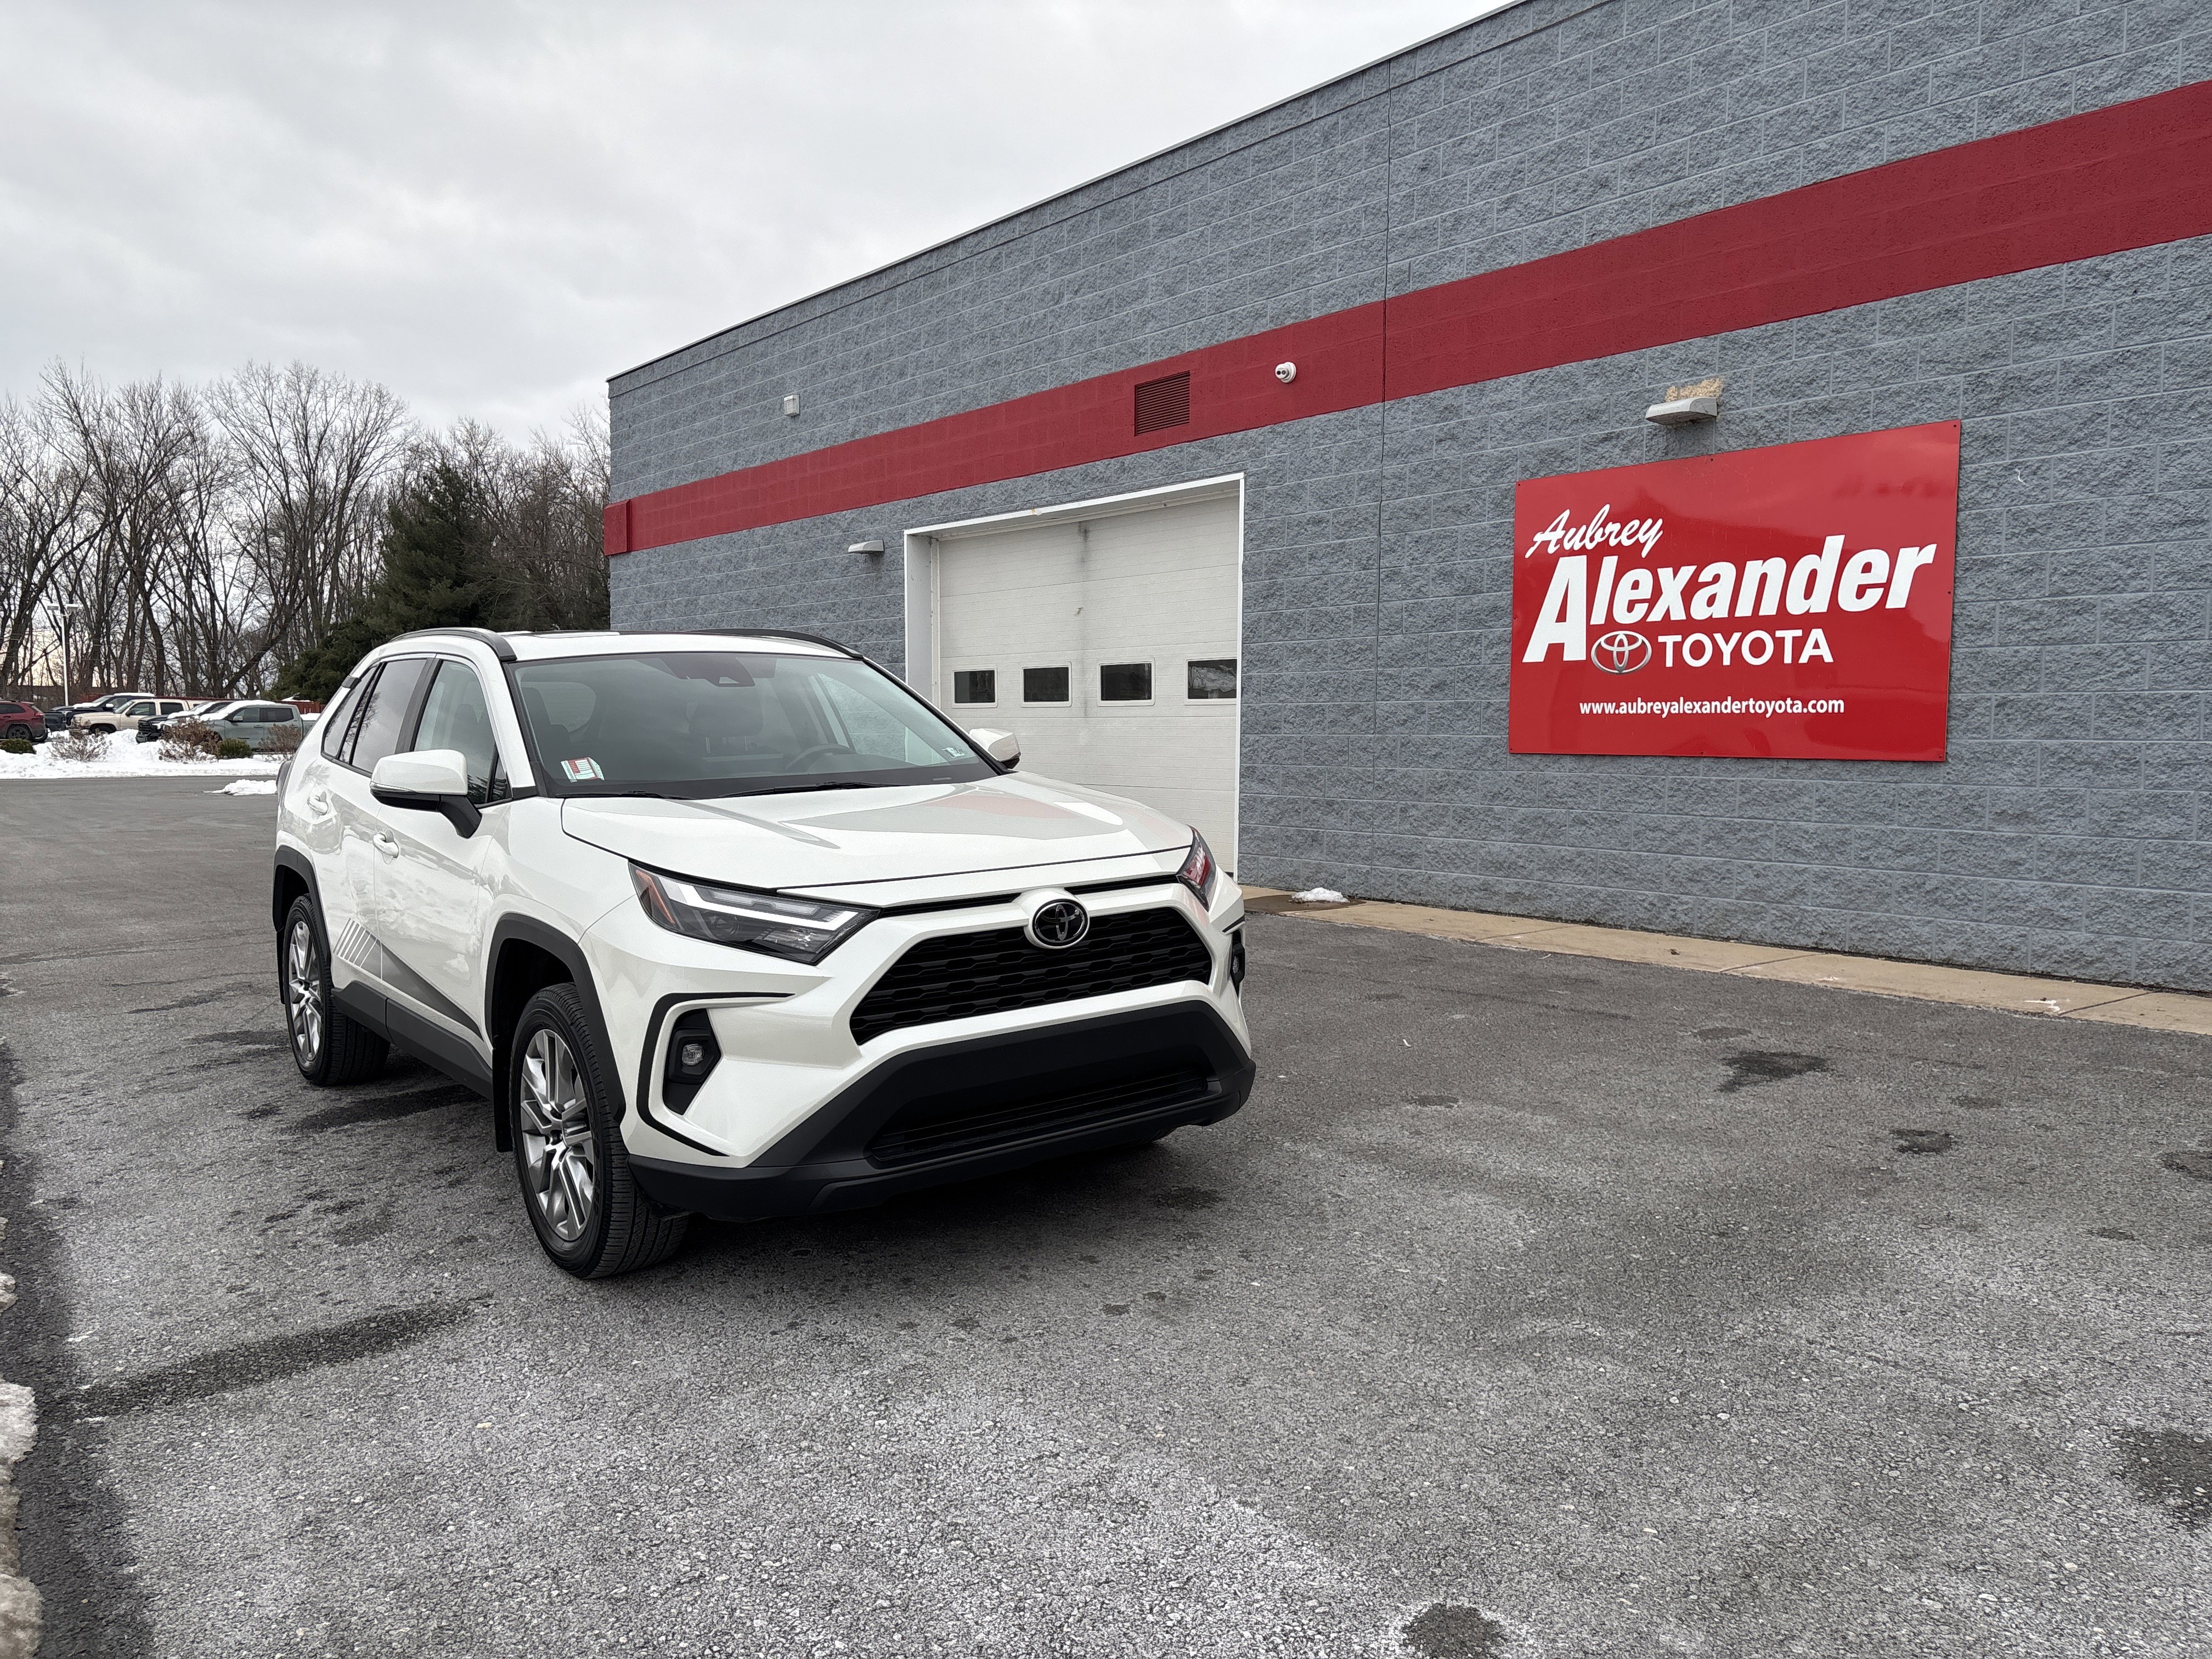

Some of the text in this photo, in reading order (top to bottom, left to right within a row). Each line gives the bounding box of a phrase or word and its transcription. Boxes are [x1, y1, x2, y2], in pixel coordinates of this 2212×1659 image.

[1525, 504, 1663, 558] Aubrey
[1522, 535, 1937, 663] Alexander
[1658, 629, 1834, 668] TOYOTA
[1579, 696, 1844, 718] www.aubreyalexandertoyota.com
